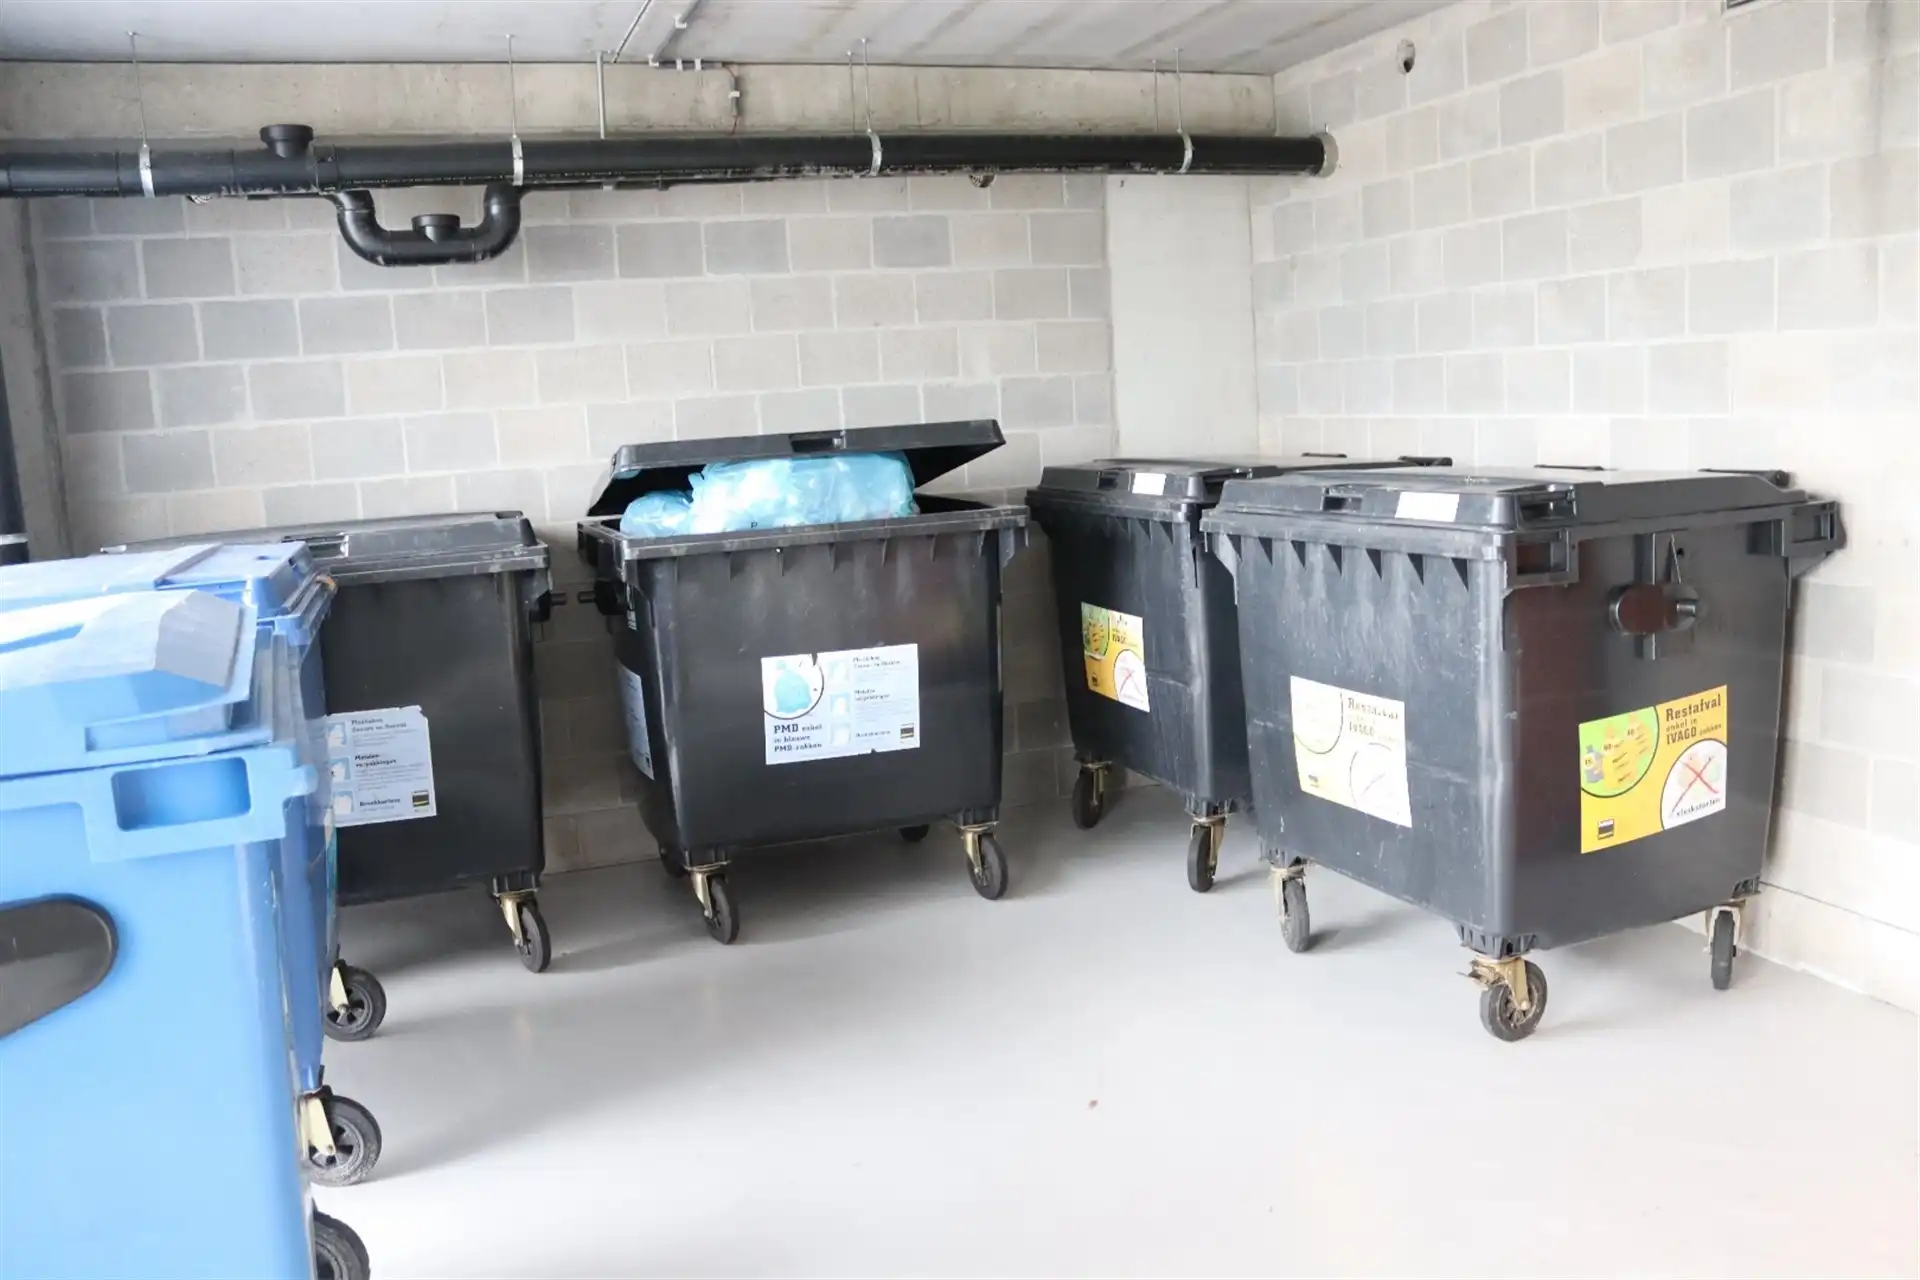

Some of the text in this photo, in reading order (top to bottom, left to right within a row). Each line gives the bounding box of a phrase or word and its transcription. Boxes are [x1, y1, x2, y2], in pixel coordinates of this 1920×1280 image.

[1666, 693, 1721, 721] Restafval
[774, 724, 799, 734] PMD
[1666, 727, 1697, 745] IVAGO
[774, 744, 793, 752] PMD
